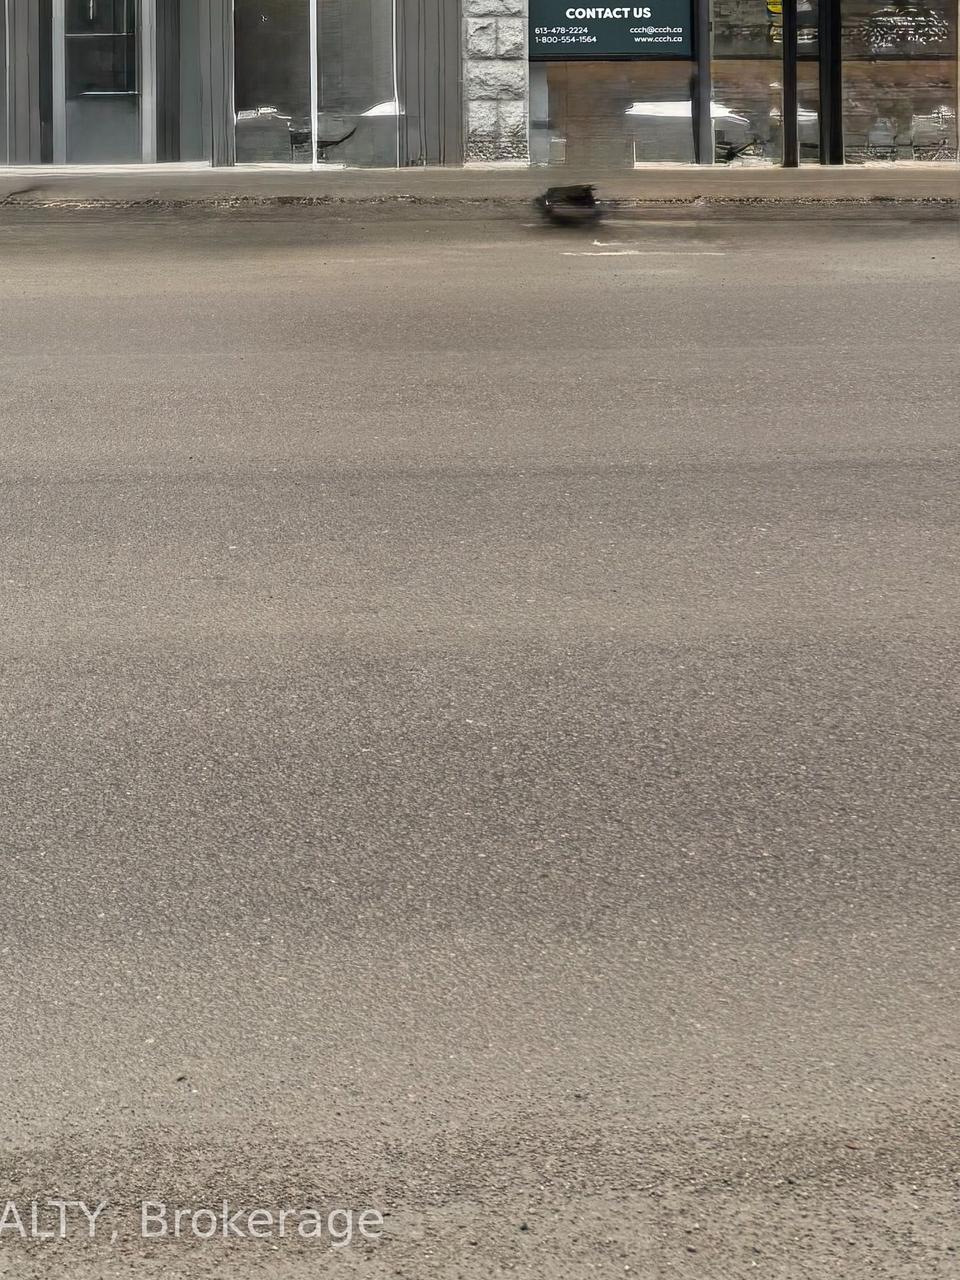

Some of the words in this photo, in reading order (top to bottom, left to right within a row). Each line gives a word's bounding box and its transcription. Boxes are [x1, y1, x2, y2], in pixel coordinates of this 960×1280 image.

[565, 7, 631, 19] CONTACT
[633, 7, 652, 18] US
[535, 26, 588, 34] 613-478-2224
[629, 26, 683, 35] ccch@ccch.ca
[535, 35, 597, 43] 1-800-554-1564
[634, 35, 683, 43] www.ccch.ca
